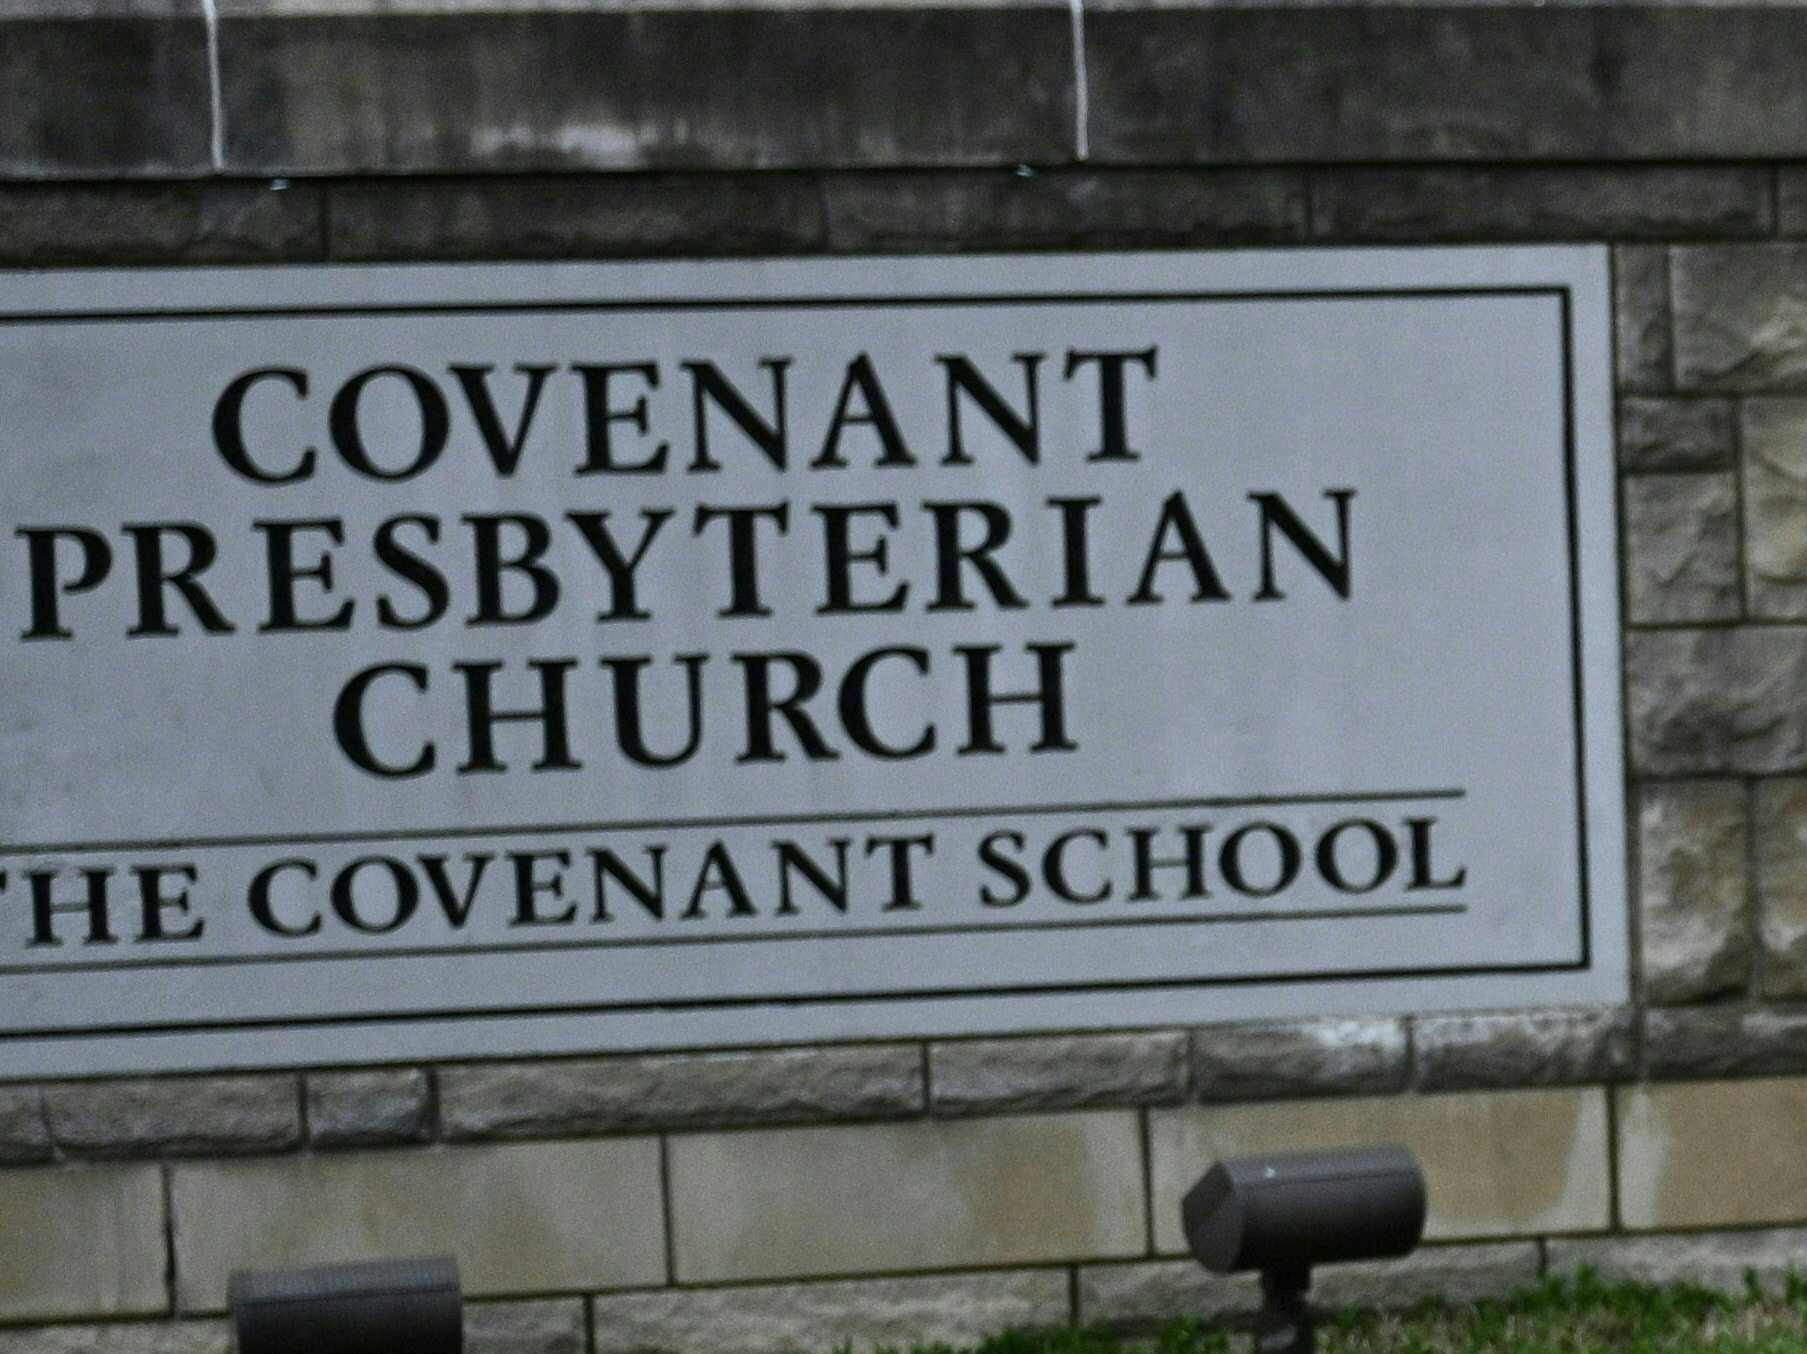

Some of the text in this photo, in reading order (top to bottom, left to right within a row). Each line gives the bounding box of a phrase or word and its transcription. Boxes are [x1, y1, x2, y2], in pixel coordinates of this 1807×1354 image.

[210, 346, 1158, 487] COVENANT
[14, 489, 1357, 642] PRESBYTERIAN
[331, 641, 1078, 780] CHURCH
[0, 817, 1468, 948] HE COVENANT SCHOOL
